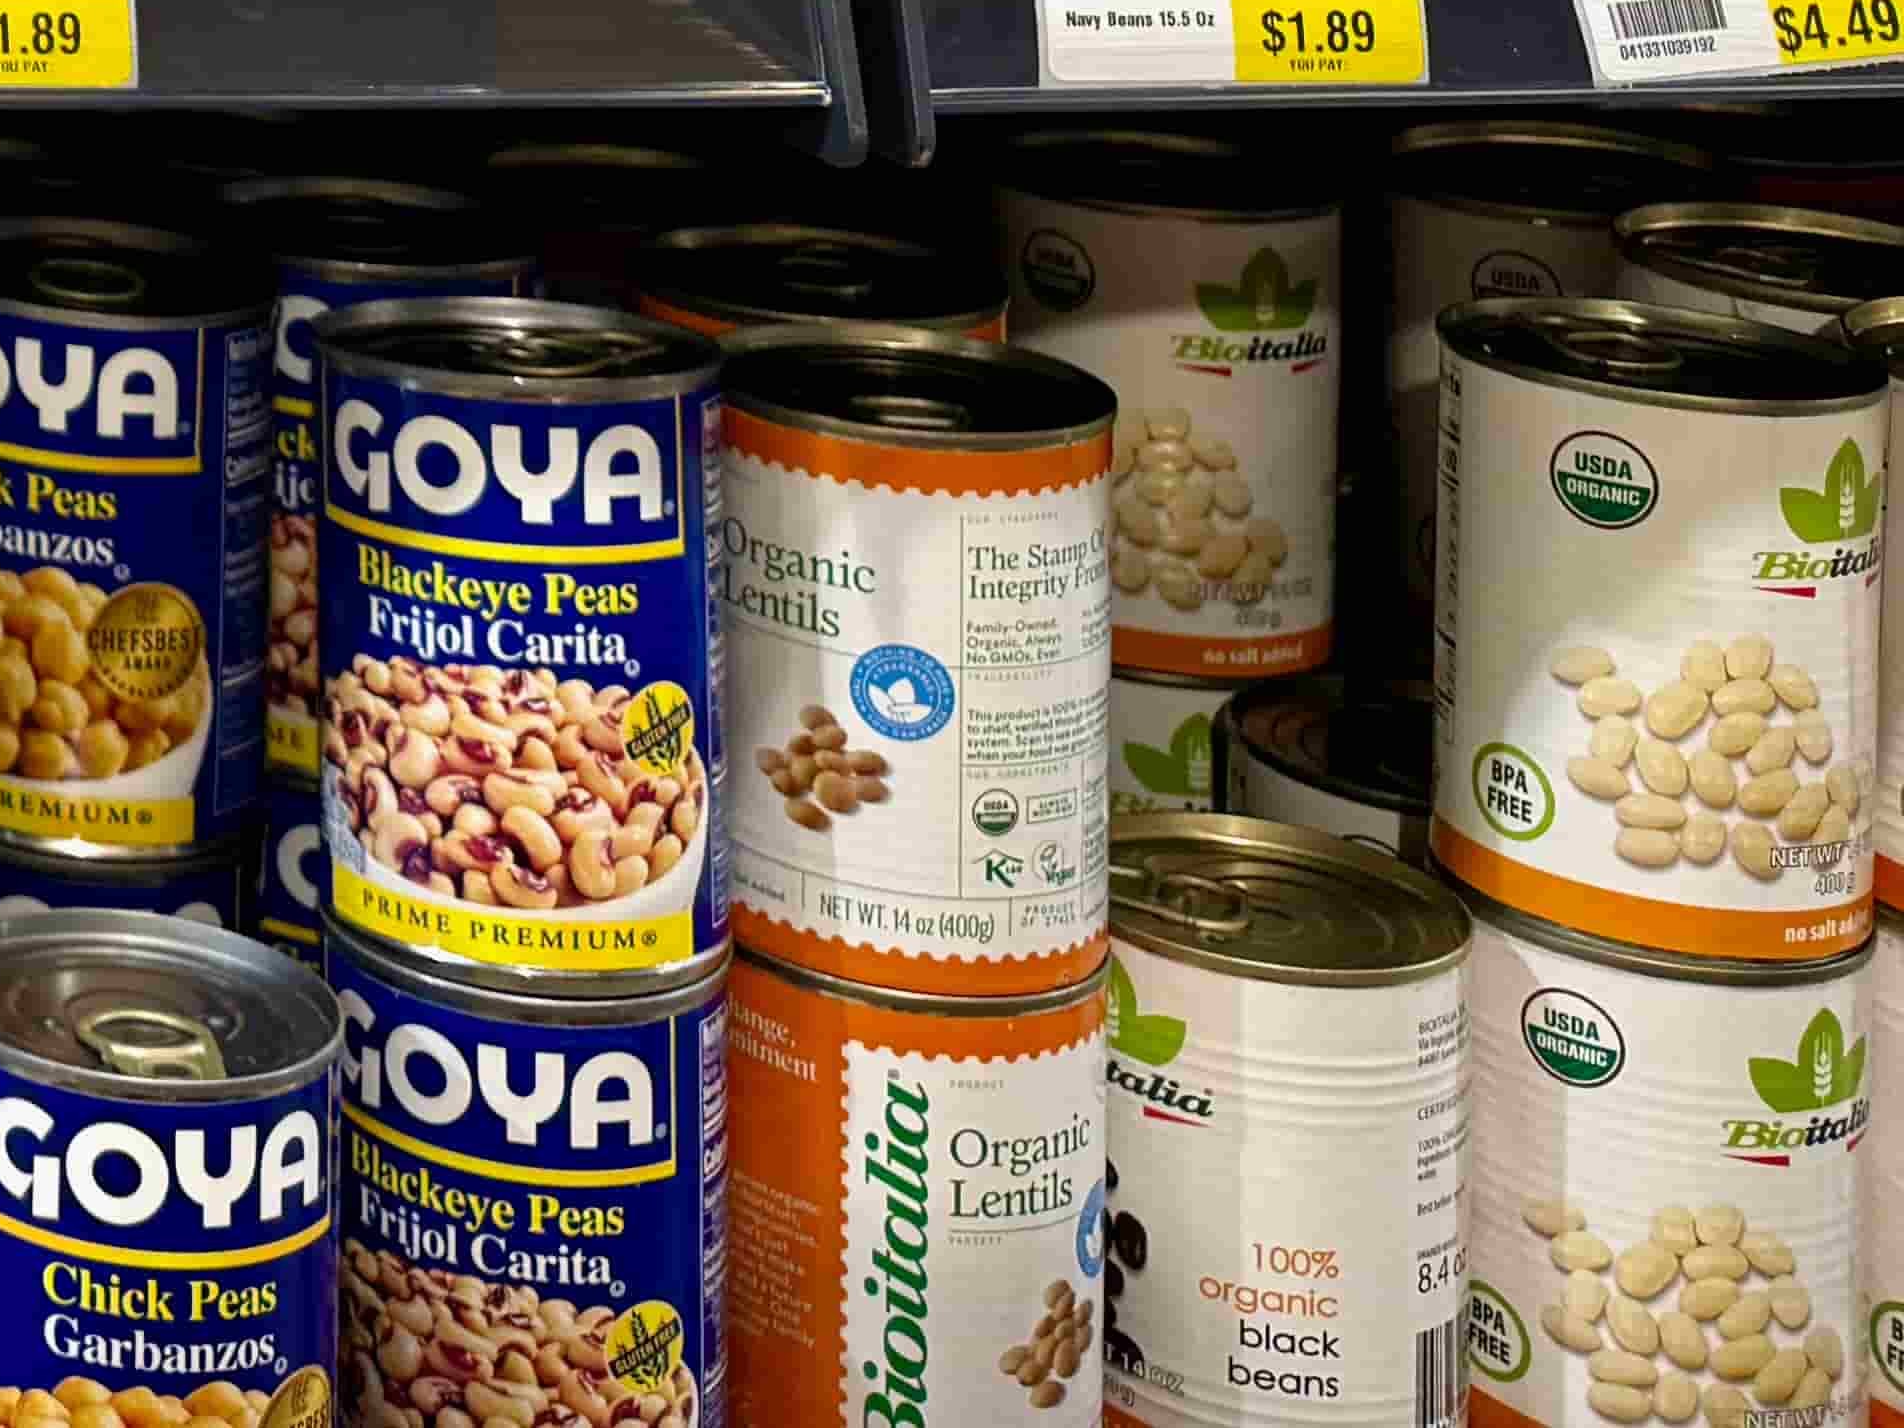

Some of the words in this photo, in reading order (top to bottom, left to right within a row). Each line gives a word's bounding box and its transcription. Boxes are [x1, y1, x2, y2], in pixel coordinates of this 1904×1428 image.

[1261, 9, 1376, 56] $1.89
[1620, 36, 1717, 61] 041331039192
[335, 399, 666, 525] GOYA
[1573, 450, 1634, 480] USDA
[1564, 479, 1643, 507] ORGANIC
[356, 544, 533, 615] Blackeye
[543, 573, 639, 616] Peas
[1490, 758, 1529, 791] BPA
[1486, 786, 1534, 825] FREE
[819, 894, 854, 921] NET
[858, 898, 888, 925] WT.
[893, 906, 915, 931] 14
[918, 910, 936, 934] oz
[939, 910, 996, 942] (400g)
[948, 1114, 1090, 1176] Organic
[948, 1172, 1073, 1223] Lentils
[1250, 1241, 1340, 1279] 100%
[1197, 1271, 1340, 1320] organic
[1238, 1320, 1340, 1361] black
[1227, 1356, 1340, 1401] beans
